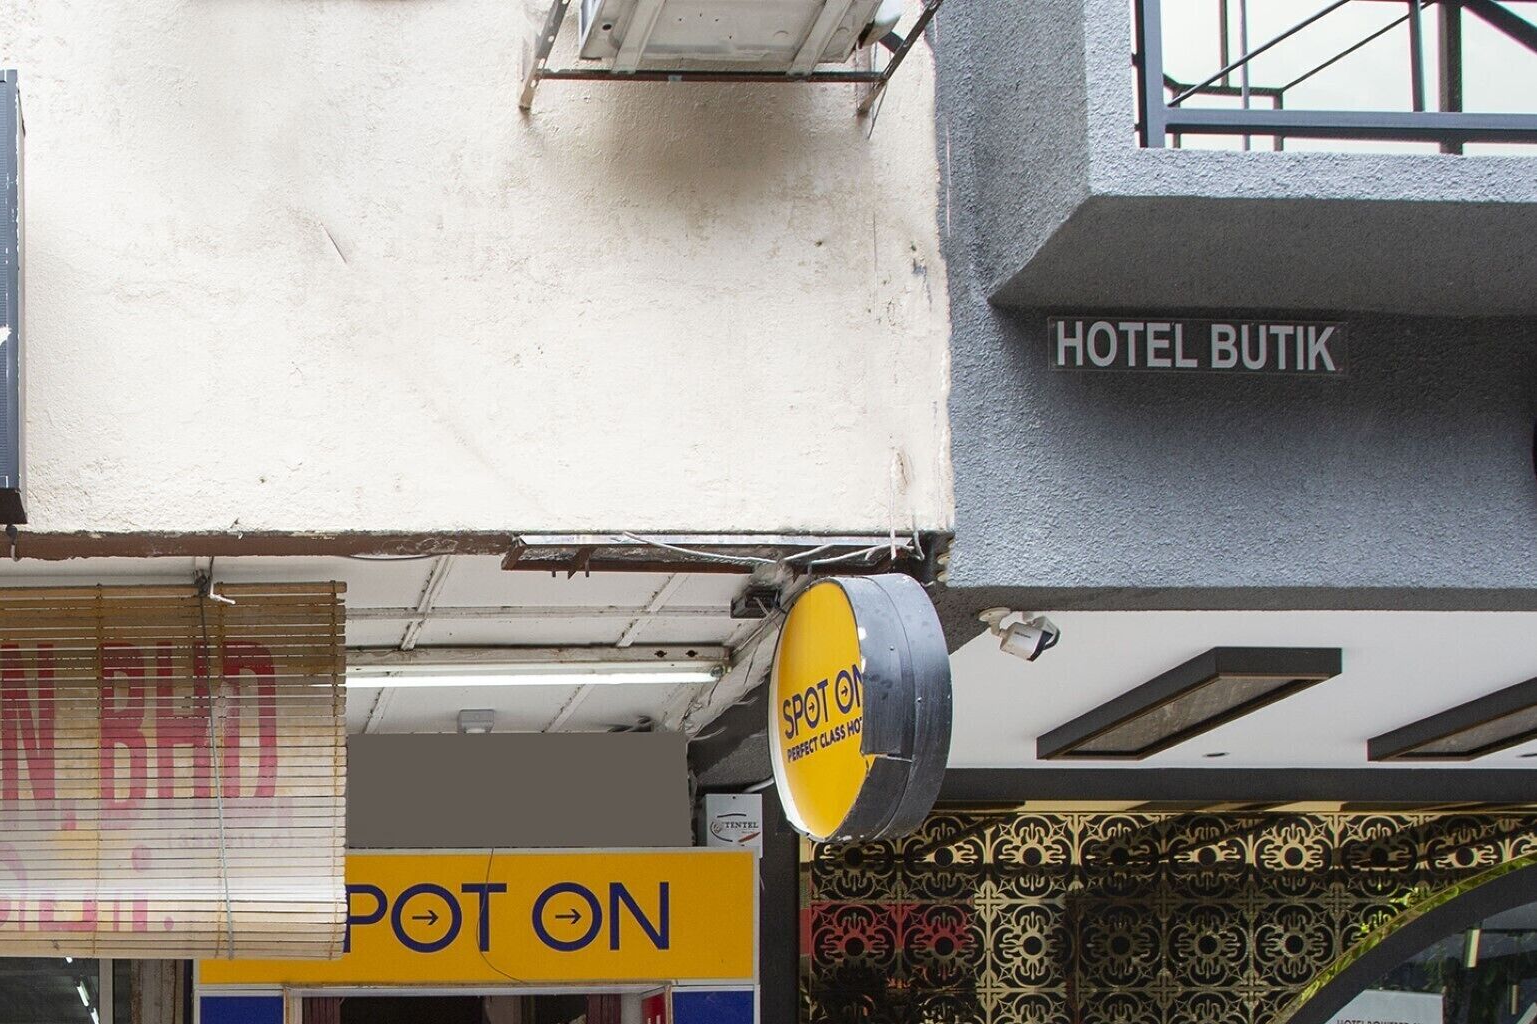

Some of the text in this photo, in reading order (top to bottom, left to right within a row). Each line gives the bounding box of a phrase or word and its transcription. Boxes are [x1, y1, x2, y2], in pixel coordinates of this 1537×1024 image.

[1057, 320, 1336, 371] HOTEL BUTIK
[782, 678, 829, 740] SPOT
[787, 736, 818, 763] PERFECT
[820, 725, 846, 750] CLASS
[343, 881, 670, 954] POT ON
